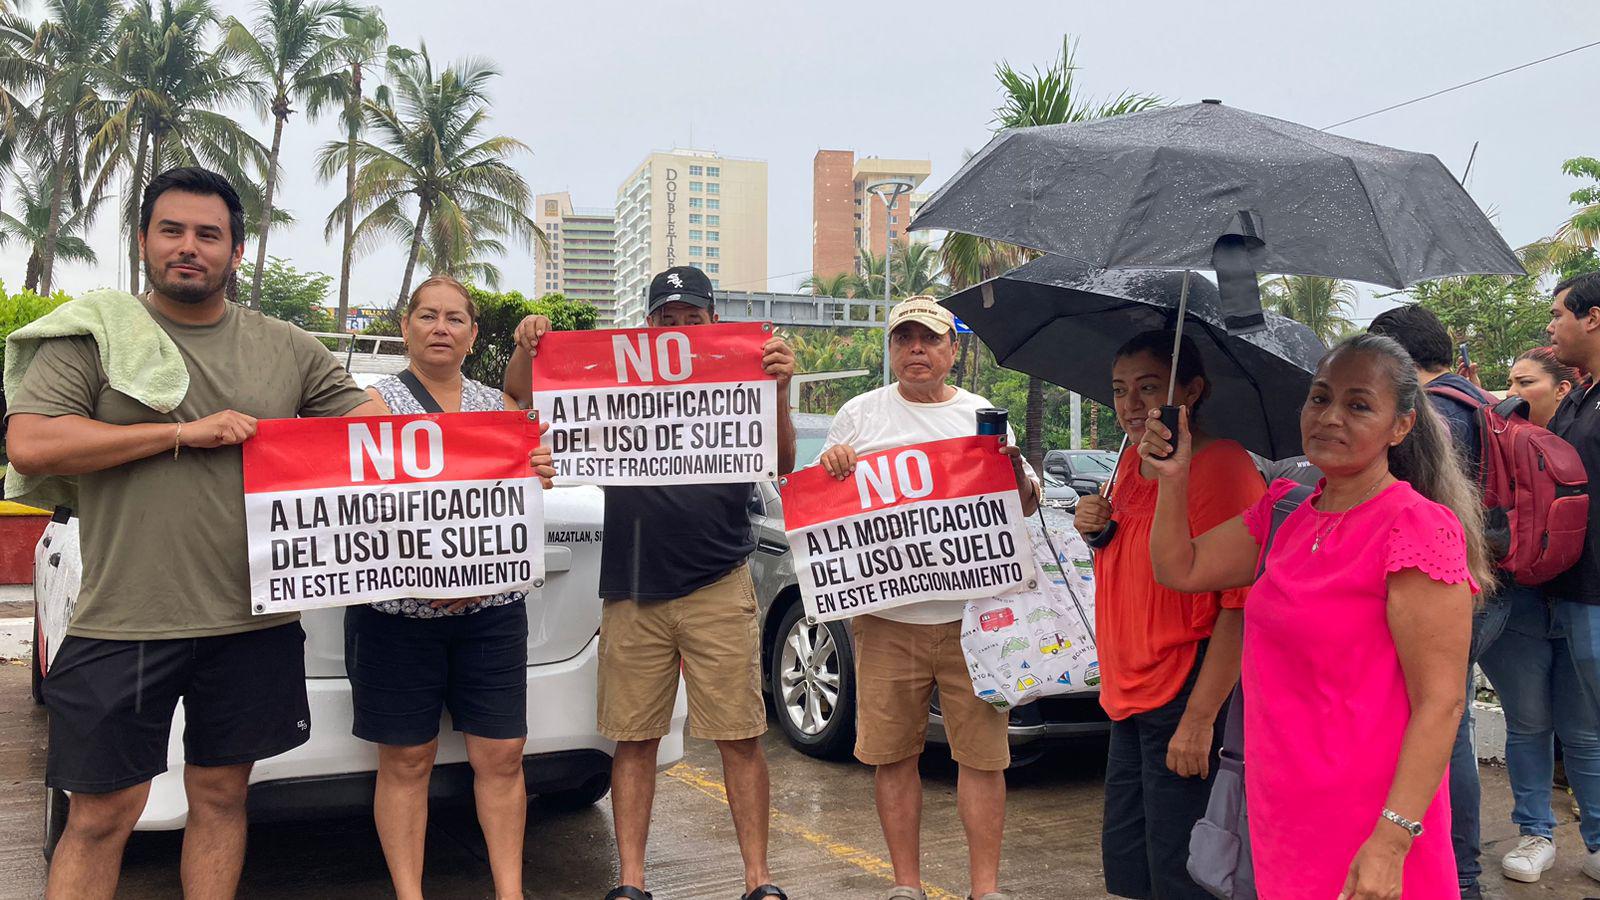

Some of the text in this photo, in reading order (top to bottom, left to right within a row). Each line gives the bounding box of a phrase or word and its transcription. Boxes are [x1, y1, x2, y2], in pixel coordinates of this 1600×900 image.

[612, 331, 693, 383] NO
[552, 383, 761, 423] A LA MODIFICACIÓN
[348, 420, 445, 482] NO
[552, 420, 762, 454] DEL USO DE SUELO
[552, 453, 763, 477] EN ESTE FRACCIONAMIENTO
[854, 449, 934, 509] NO
[270, 481, 525, 532] A LA MODIFICACIÓN
[806, 496, 1008, 557] A LA MODIFICACIÓN
[271, 522, 528, 571] DEL USO DE SUELO
[547, 530, 593, 544] MAZATLAN,
[810, 530, 1015, 588] DEL USO DE SUELO
[270, 559, 531, 601] EN ESTE FRACCIONAMIENTO
[815, 562, 1023, 614] EN ESTE FRACCIONAMIENTO
